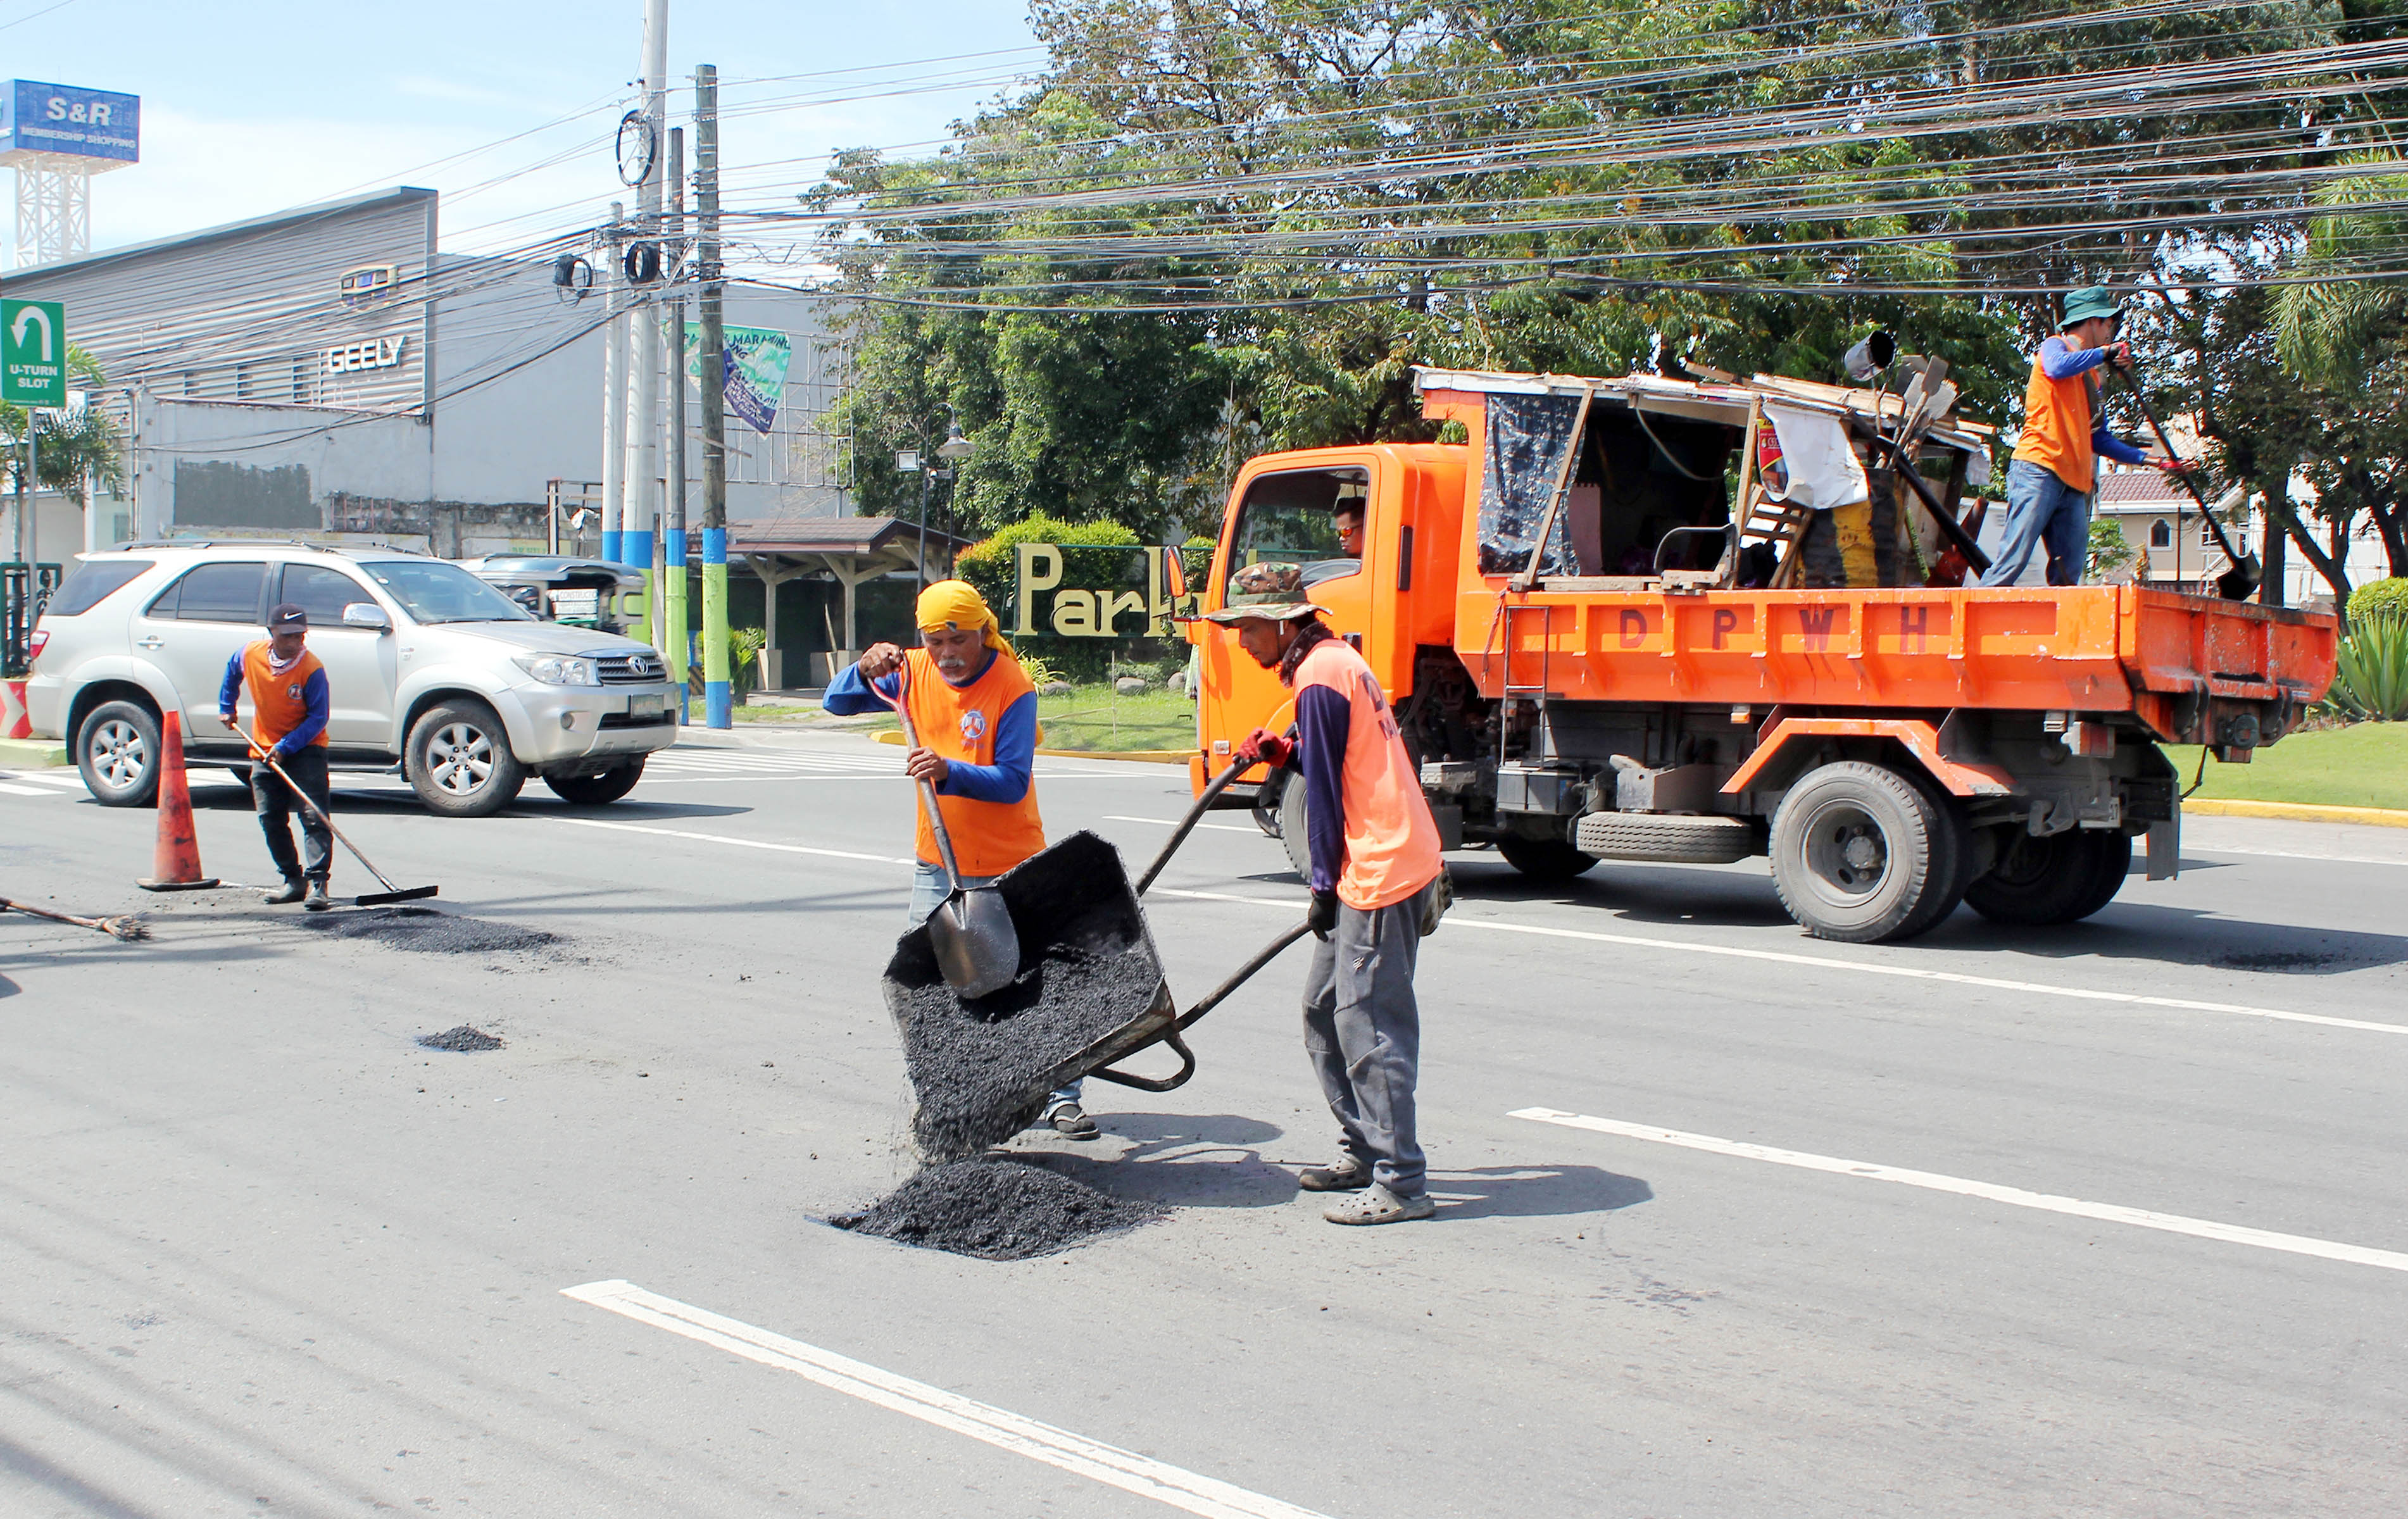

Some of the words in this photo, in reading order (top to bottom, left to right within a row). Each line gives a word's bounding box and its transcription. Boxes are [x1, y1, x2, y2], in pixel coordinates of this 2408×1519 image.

[46, 97, 112, 126] S&R
[21, 126, 86, 142] MEMBERSHIP
[87, 134, 137, 149] SHOPPING
[328, 334, 407, 374] GEELY
[9, 364, 58, 377] U-TURN
[17, 377, 51, 389] SLOT
